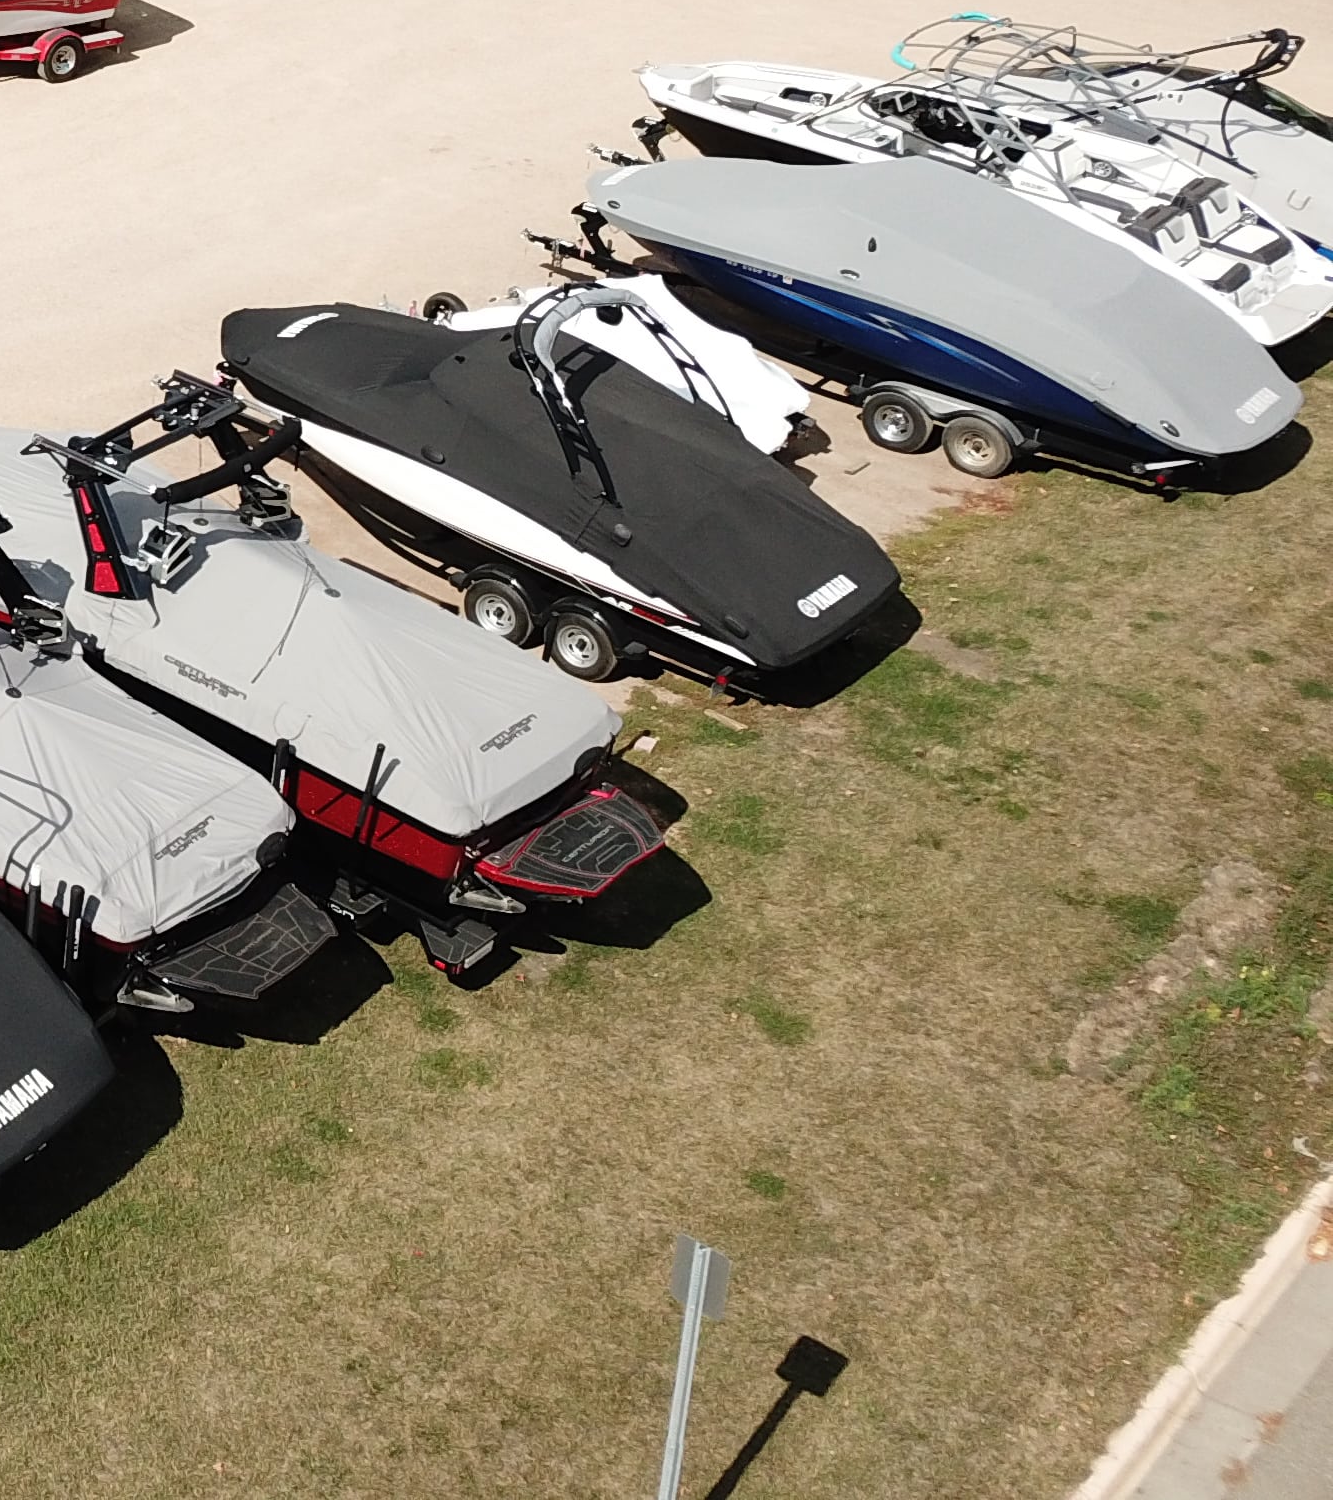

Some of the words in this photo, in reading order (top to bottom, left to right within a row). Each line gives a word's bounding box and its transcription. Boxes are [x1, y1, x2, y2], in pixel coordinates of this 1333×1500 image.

[805, 574, 859, 611] YAMAHA
[163, 654, 248, 701] CENTURION
[479, 713, 538, 753] CENTURION
[153, 814, 216, 861] CENTURION
[560, 824, 615, 863] CENTURION
